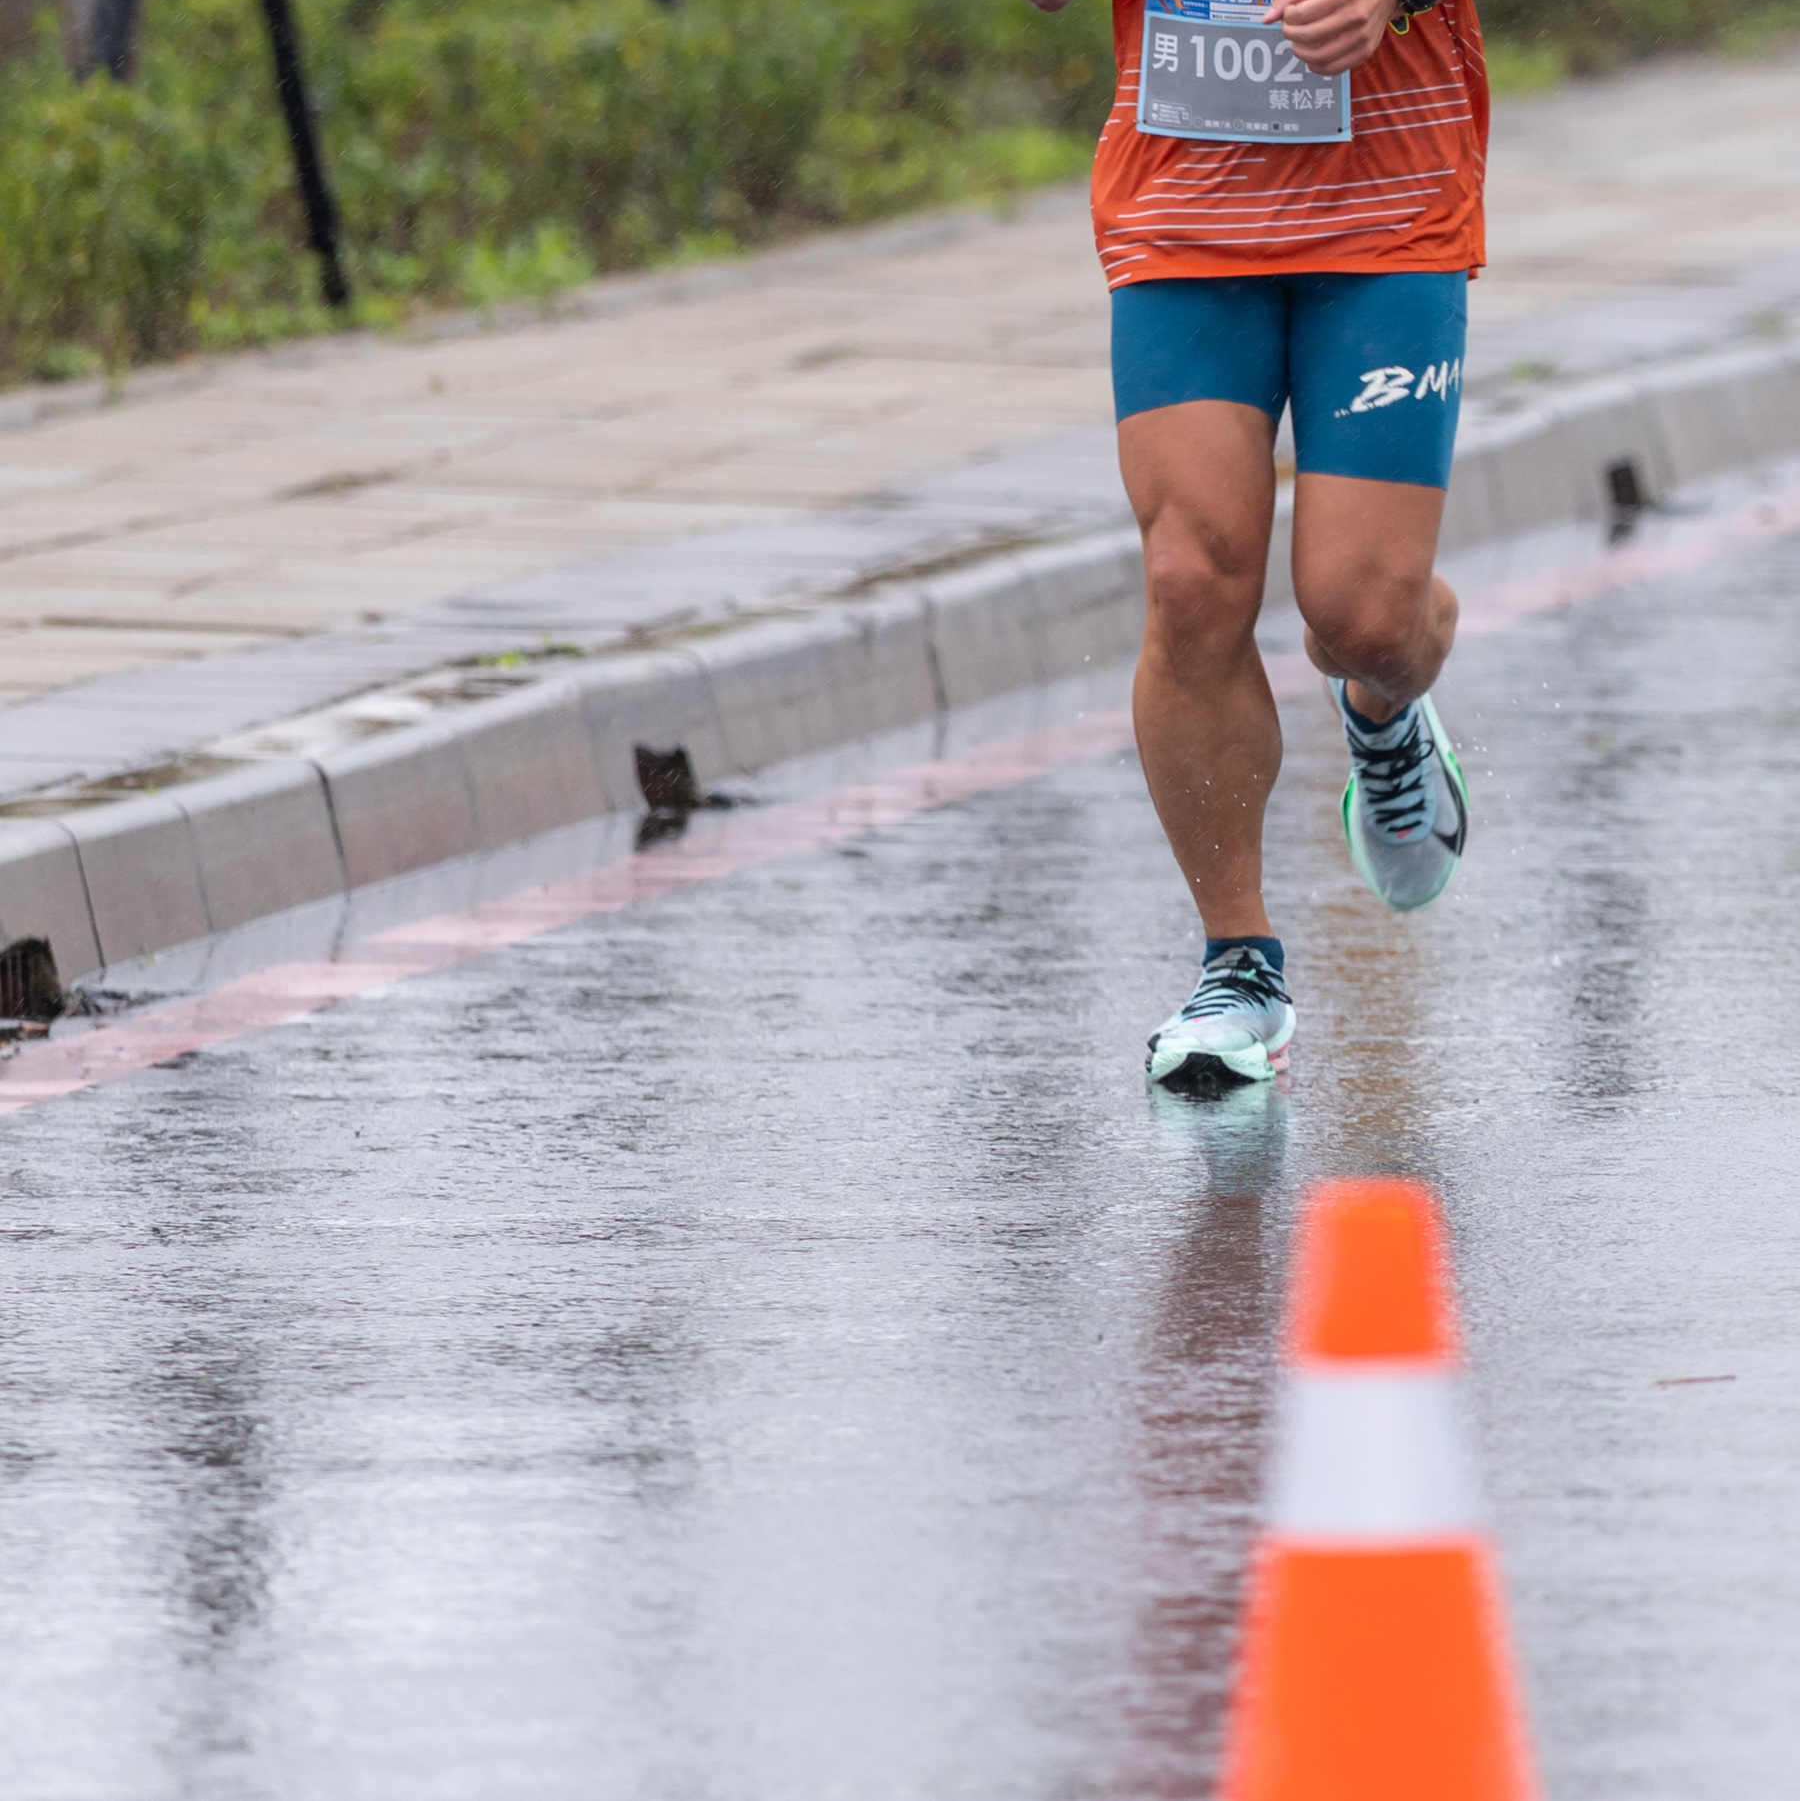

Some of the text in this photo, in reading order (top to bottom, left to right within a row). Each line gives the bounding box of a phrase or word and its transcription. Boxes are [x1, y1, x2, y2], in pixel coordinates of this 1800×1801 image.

[1152, 32, 1333, 83] 男 1002
[1268, 88, 1336, 111] 蔡松昇
